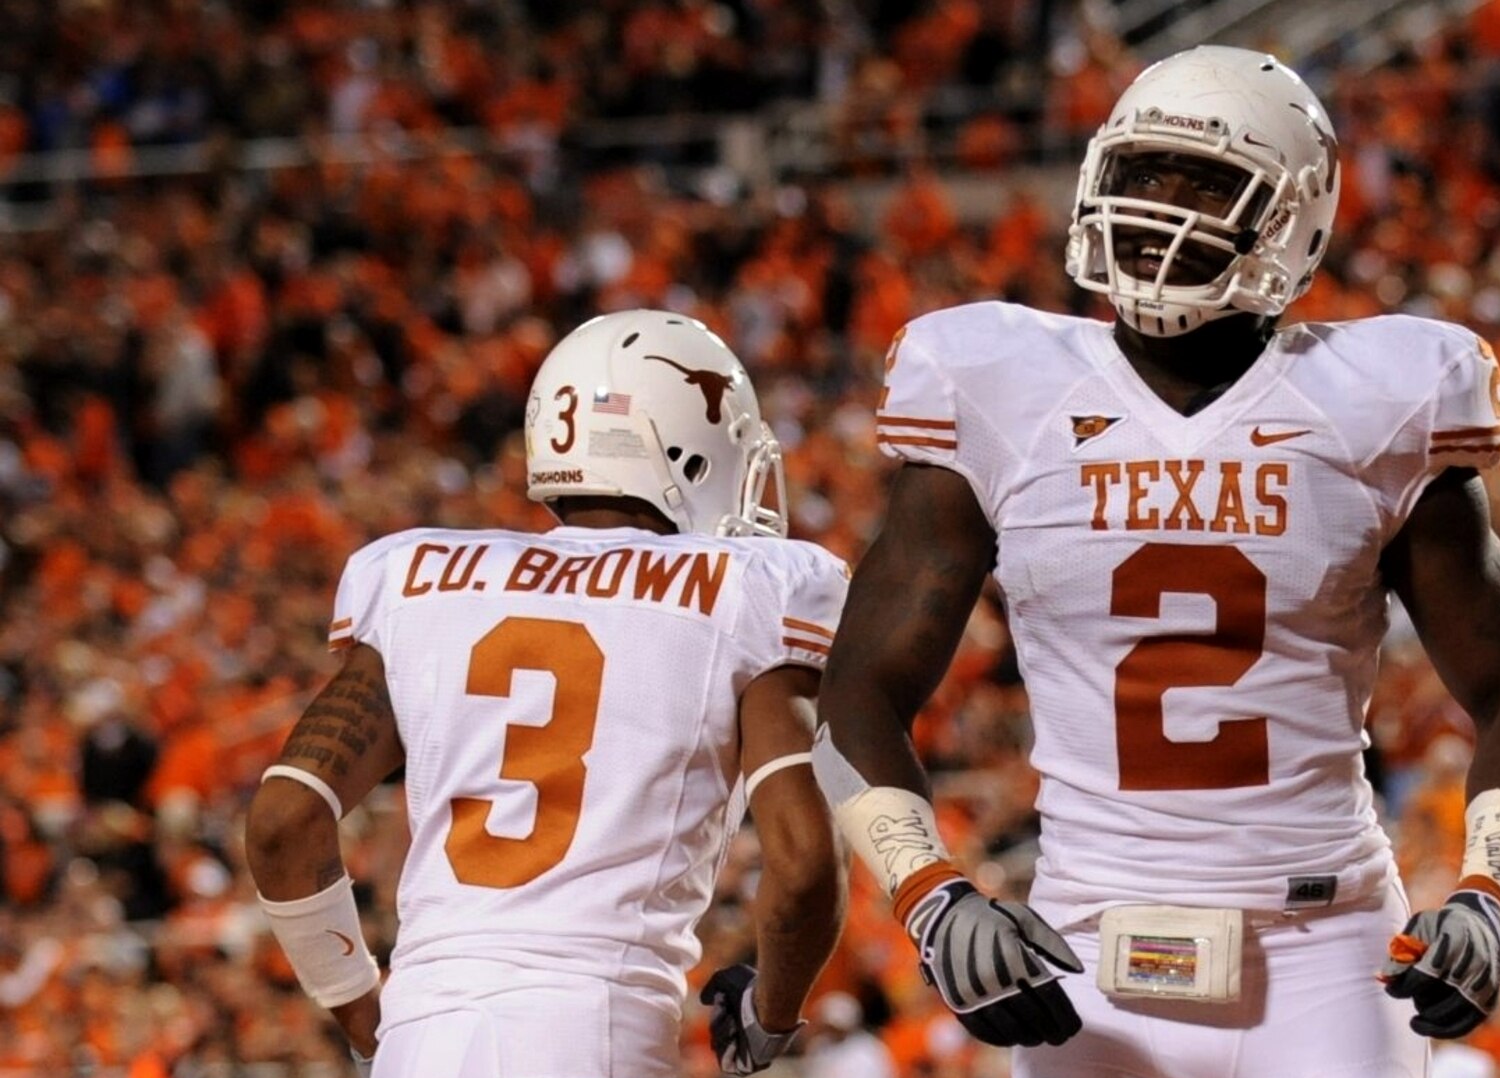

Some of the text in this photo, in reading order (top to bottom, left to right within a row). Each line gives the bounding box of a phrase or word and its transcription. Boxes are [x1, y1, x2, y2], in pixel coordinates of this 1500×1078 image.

[550, 385, 579, 455] 3
[1080, 459, 1289, 536] TEXAS
[402, 542, 730, 617] CU. BROWN
[1109, 542, 1269, 789] 2
[443, 615, 606, 890] 3
